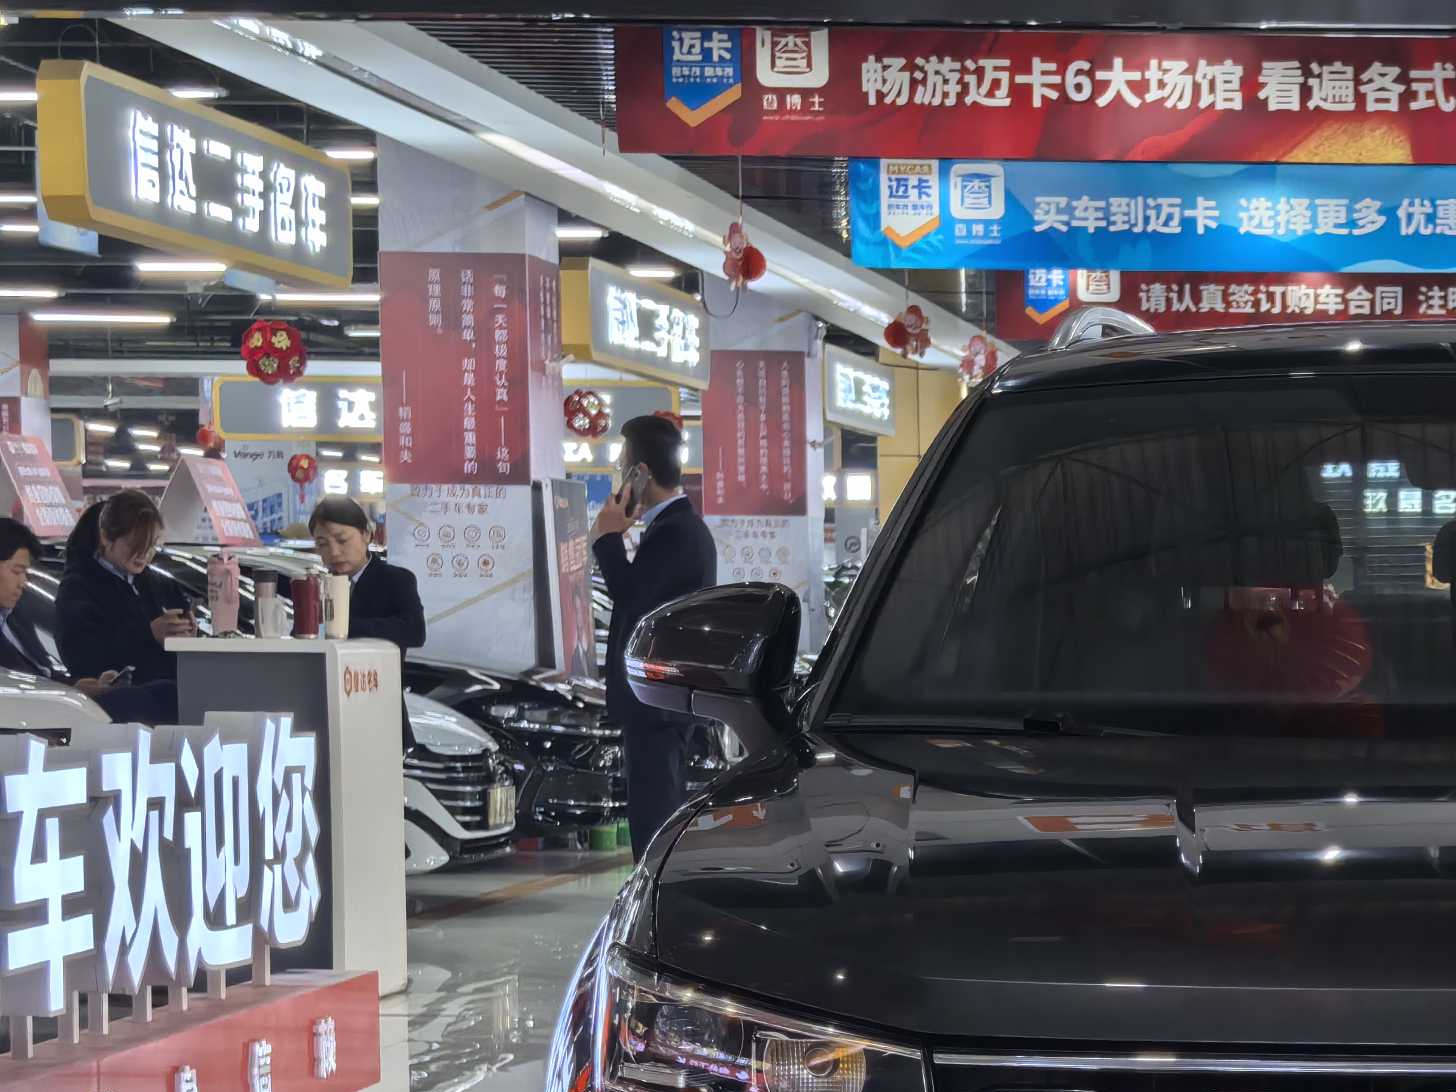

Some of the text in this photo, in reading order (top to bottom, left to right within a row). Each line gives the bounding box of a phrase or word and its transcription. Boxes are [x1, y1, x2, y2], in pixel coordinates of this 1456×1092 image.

[671, 31, 732, 62] 迈卡
[861, 55, 1242, 111] 畅游迈卡6大场馆
[129, 108, 328, 255] 信达二手名车
[888, 176, 932, 200] 迈卡
[1033, 196, 1219, 234] 买车到迈卡
[1239, 198, 1386, 236] 选择更多
[1028, 269, 1064, 286] 迈卡
[1139, 283, 1402, 316] 请认真签订购车合同
[3, 716, 320, 1016] 车欢迎您
